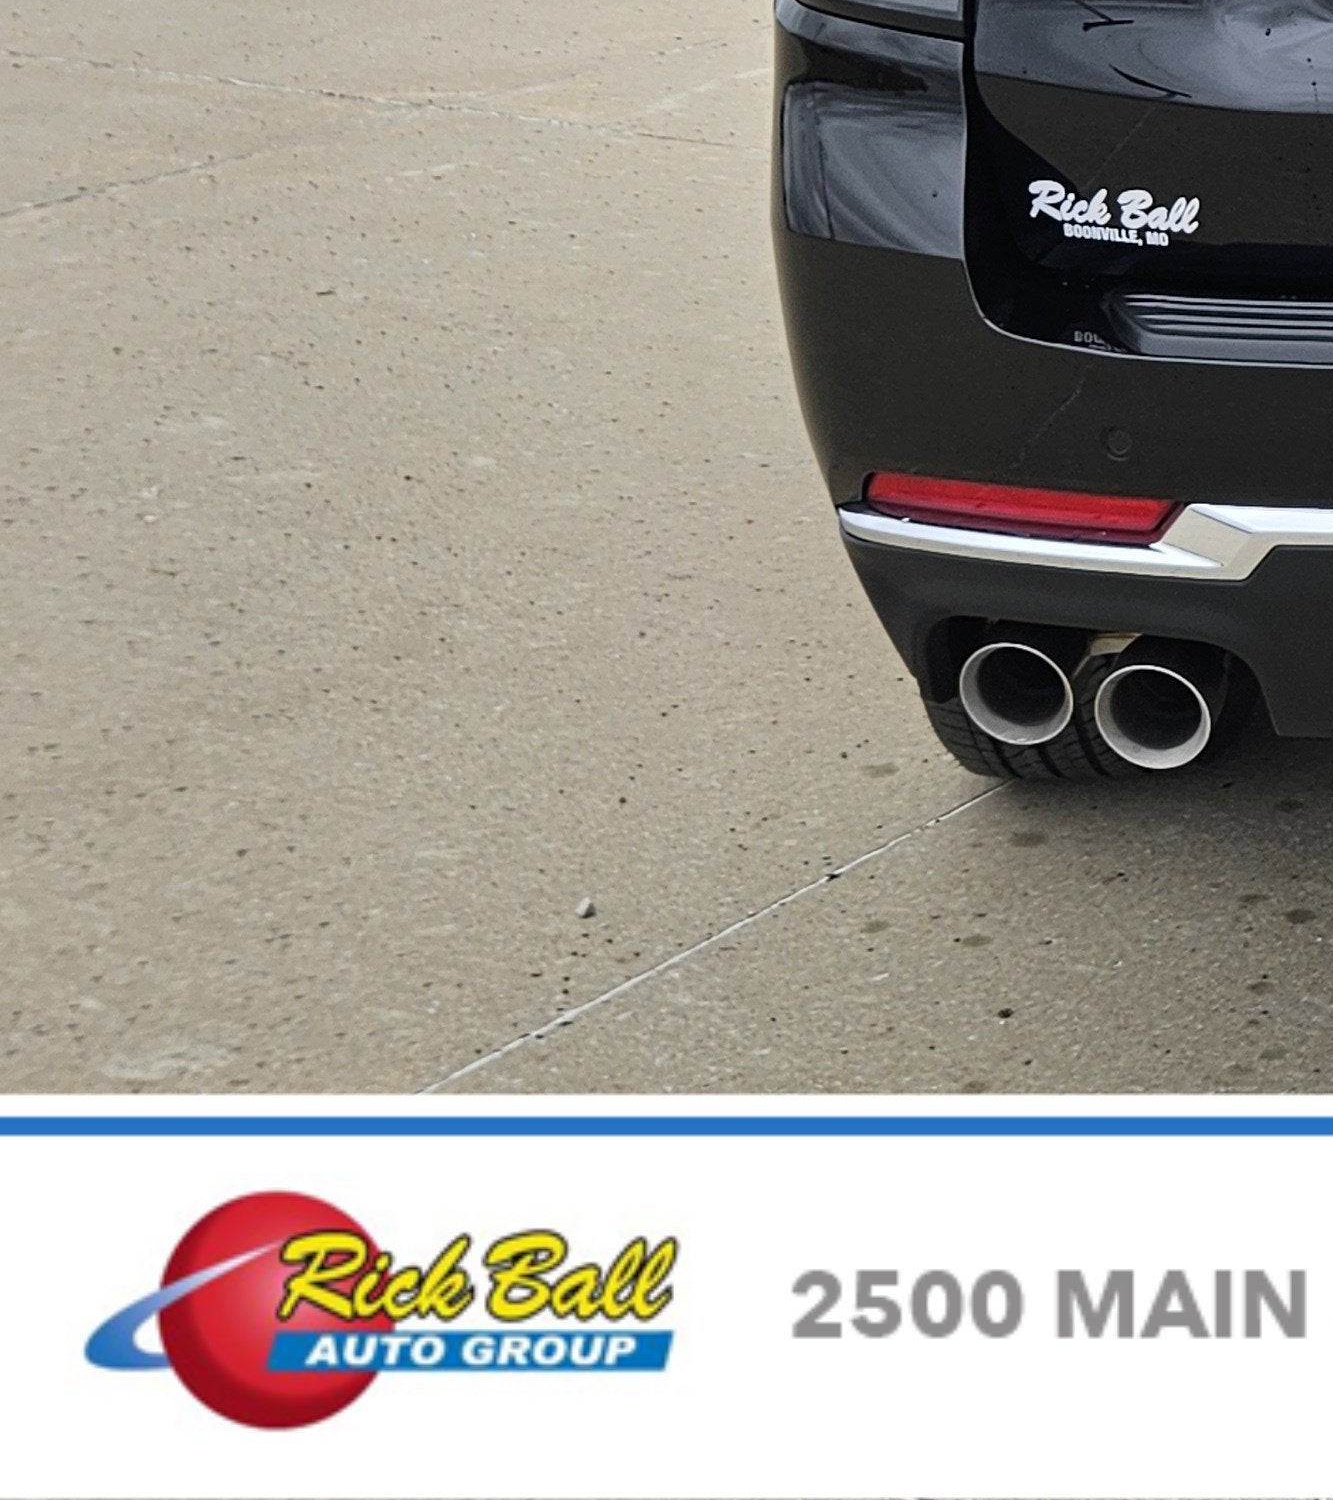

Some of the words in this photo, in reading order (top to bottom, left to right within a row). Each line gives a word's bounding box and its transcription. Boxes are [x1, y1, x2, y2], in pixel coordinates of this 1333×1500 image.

[1028, 180, 1111, 224] Rick
[1117, 189, 1200, 233] Ball
[1063, 222, 1143, 246] BOONVILLE,
[1146, 231, 1169, 246] MO
